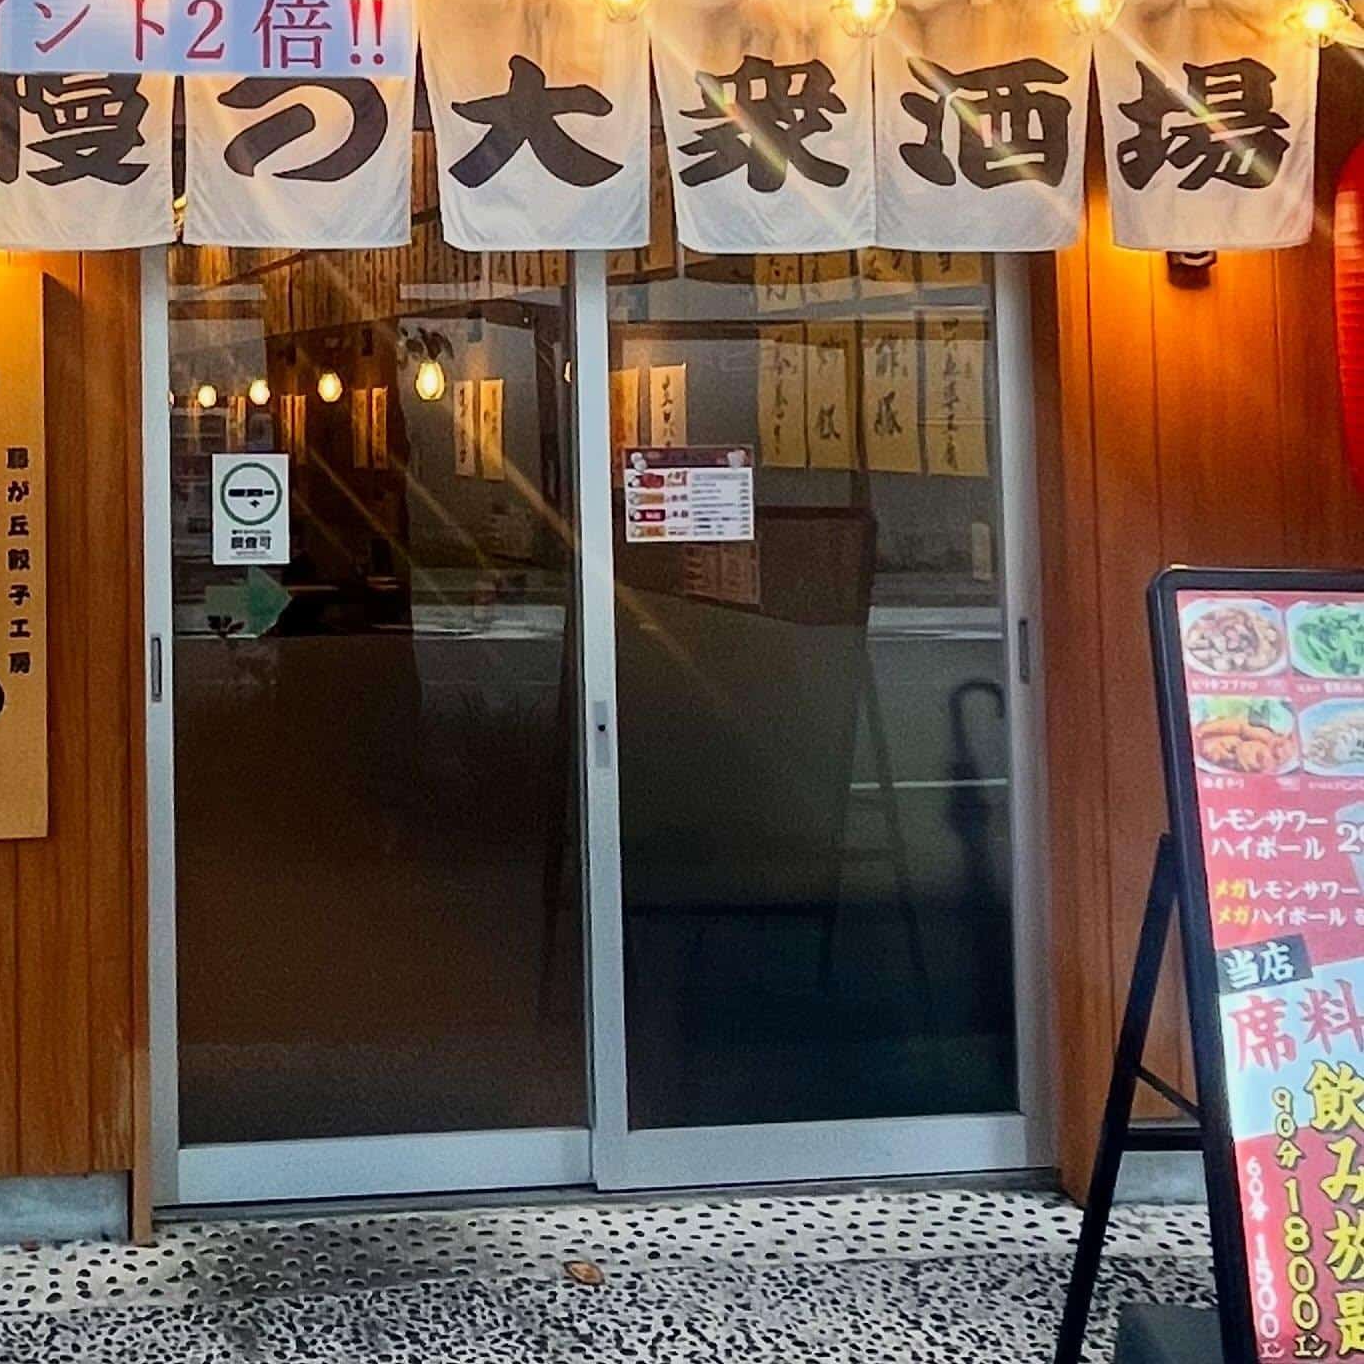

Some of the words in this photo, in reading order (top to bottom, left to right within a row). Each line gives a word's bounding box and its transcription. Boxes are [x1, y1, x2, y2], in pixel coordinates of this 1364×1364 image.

[1207, 807, 1328, 832] レモンサワー
[1211, 836, 1325, 860] ハイボール
[1223, 941, 1295, 989] 当店
[1228, 979, 1364, 1072] 席料
